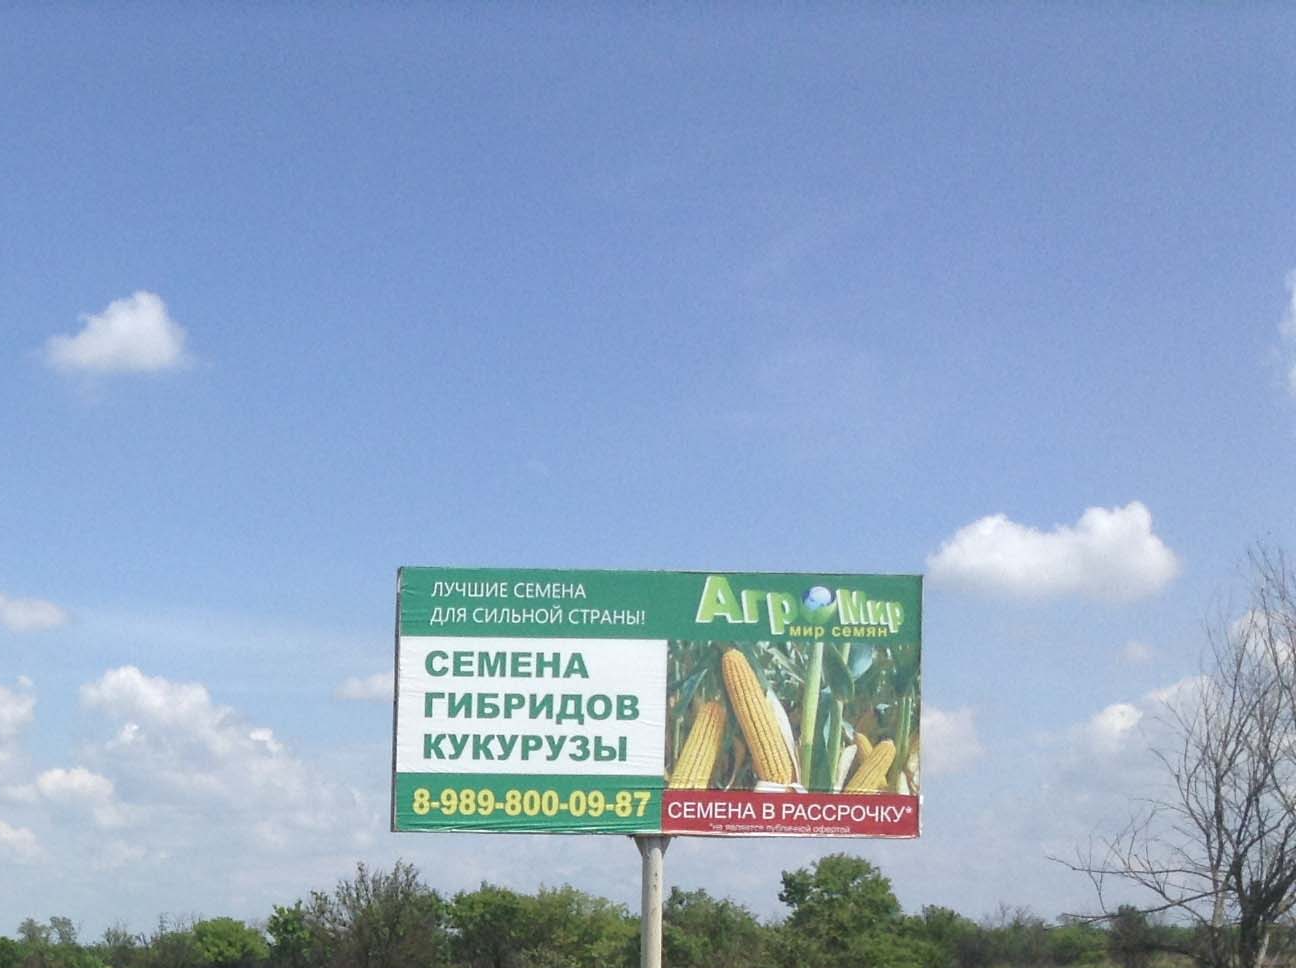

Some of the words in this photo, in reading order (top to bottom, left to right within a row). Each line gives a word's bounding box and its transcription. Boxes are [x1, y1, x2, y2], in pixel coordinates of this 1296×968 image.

[431, 581, 508, 598] ЛУЧШИЕ
[513, 582, 586, 599] СЕМЕНА
[430, 607, 467, 626] ДЛЯ
[472, 605, 563, 624] СИЛЬНОЙ
[568, 609, 646, 625] СТРАНЫ!
[789, 626, 825, 639] мир
[831, 627, 889, 638] семян
[424, 650, 590, 679] СЕМЕНА
[424, 692, 640, 725] ГИБРИДОВ
[423, 733, 628, 762] КУКУРУЗЫ
[412, 788, 651, 817] 8-989-800-09-87
[667, 801, 756, 820] СЕМЕНА
[762, 803, 776, 819] В
